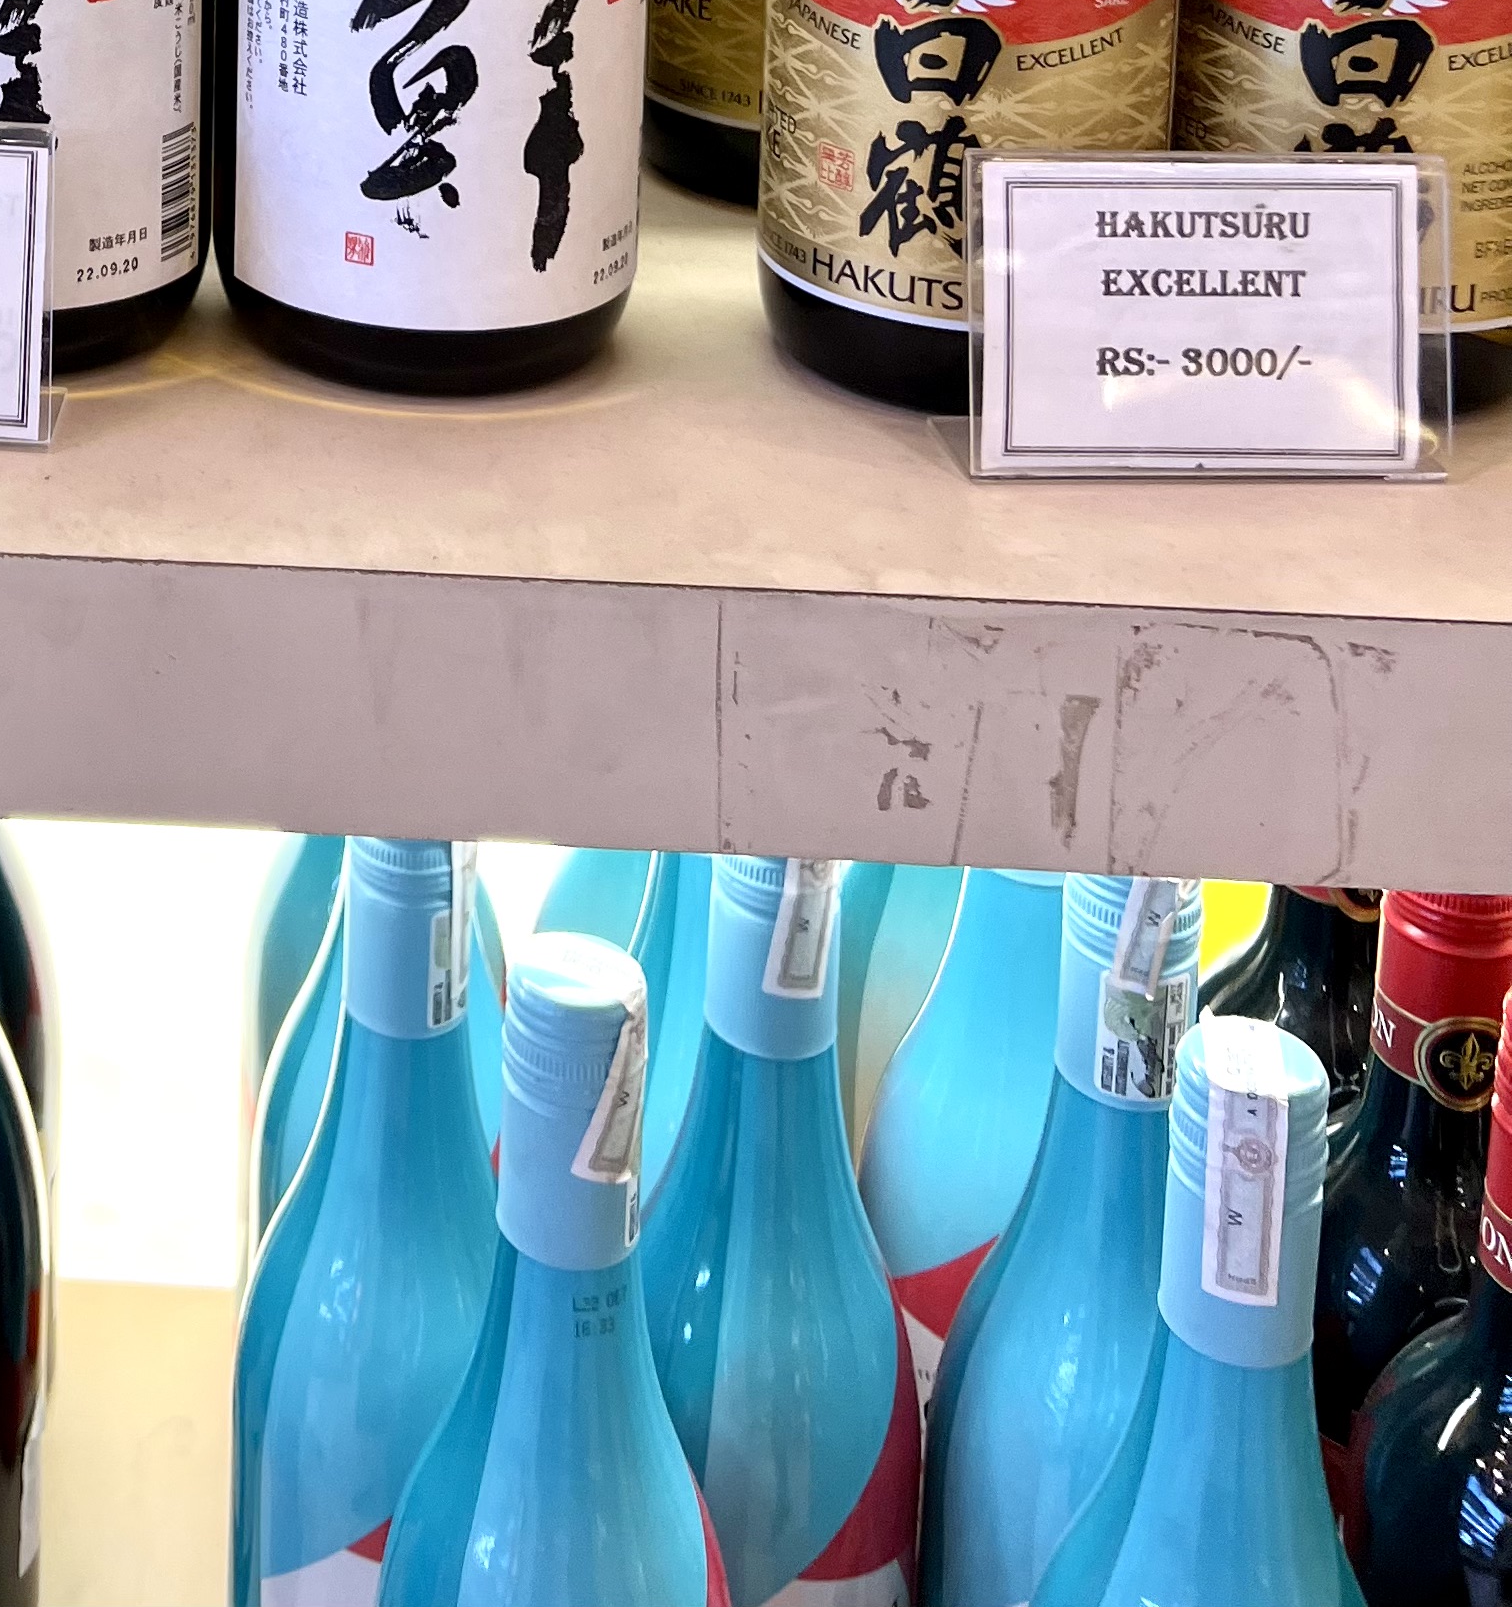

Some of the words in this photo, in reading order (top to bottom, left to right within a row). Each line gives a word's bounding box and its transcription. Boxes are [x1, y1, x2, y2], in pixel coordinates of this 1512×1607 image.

[1015, 27, 1125, 73] EXCELLENT
[89, 227, 147, 252] 製造年月日
[76, 257, 139, 282] 22.09.20
[812, 247, 964, 310] HAKUTS
[1101, 269, 1306, 297] EXCELLENT
[1181, 345, 1312, 380] 3000/-
